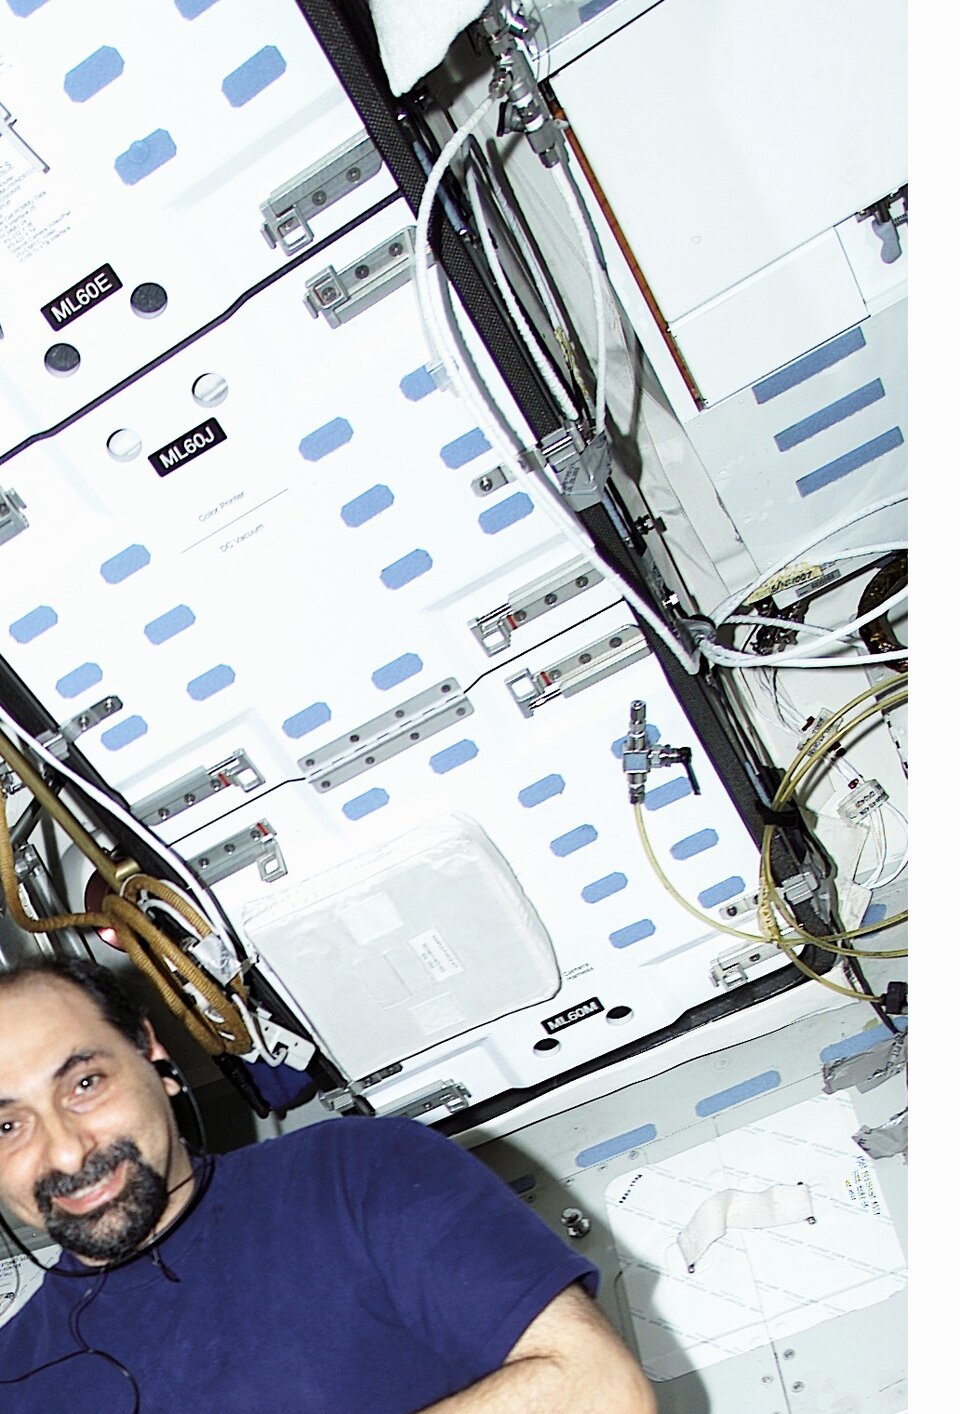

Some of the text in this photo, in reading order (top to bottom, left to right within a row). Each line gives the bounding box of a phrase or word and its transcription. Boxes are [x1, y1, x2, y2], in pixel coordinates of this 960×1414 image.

[51, 272, 113, 323] ML60E
[159, 426, 215, 469] ML60J
[547, 1001, 599, 1031] ML60M
